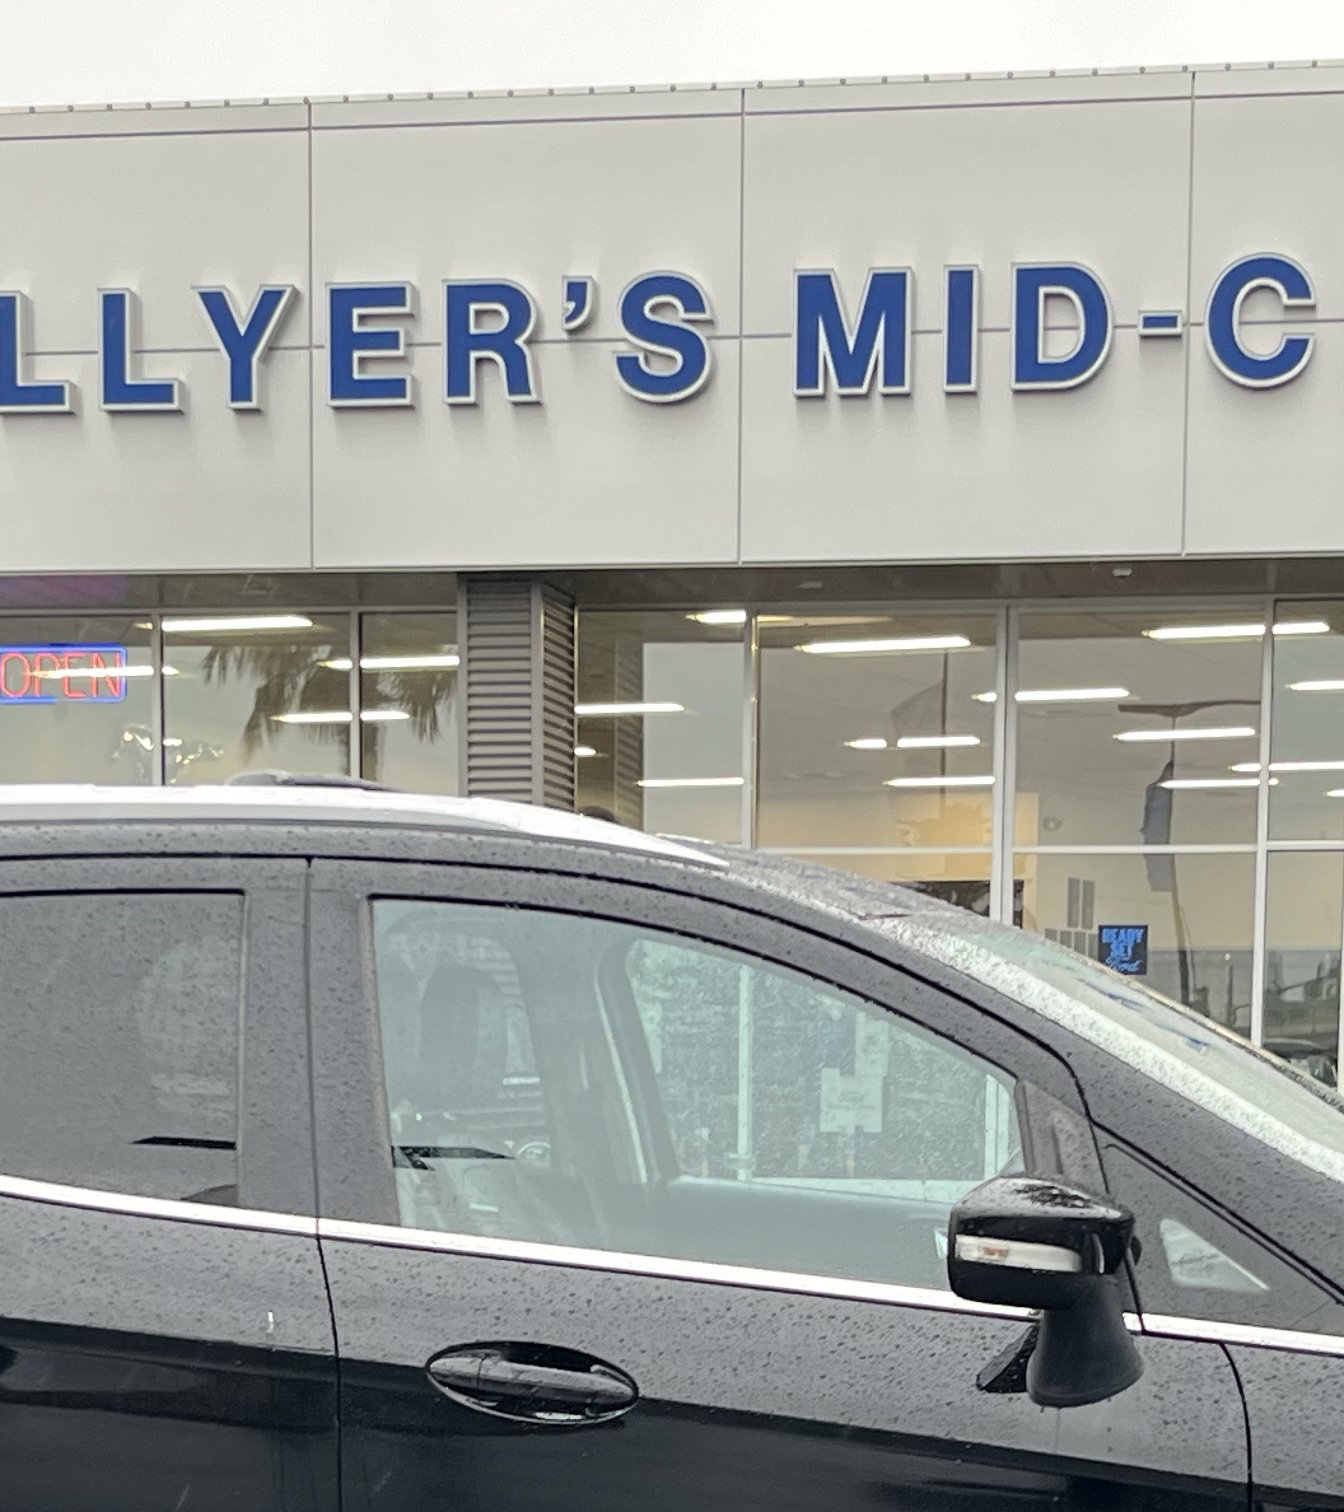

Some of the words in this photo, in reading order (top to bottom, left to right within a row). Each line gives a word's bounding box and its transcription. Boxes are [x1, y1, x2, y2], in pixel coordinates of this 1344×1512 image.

[0, 652, 122, 698] OPEN
[1102, 928, 1144, 943] READY
[1110, 942, 1133, 958] SET
